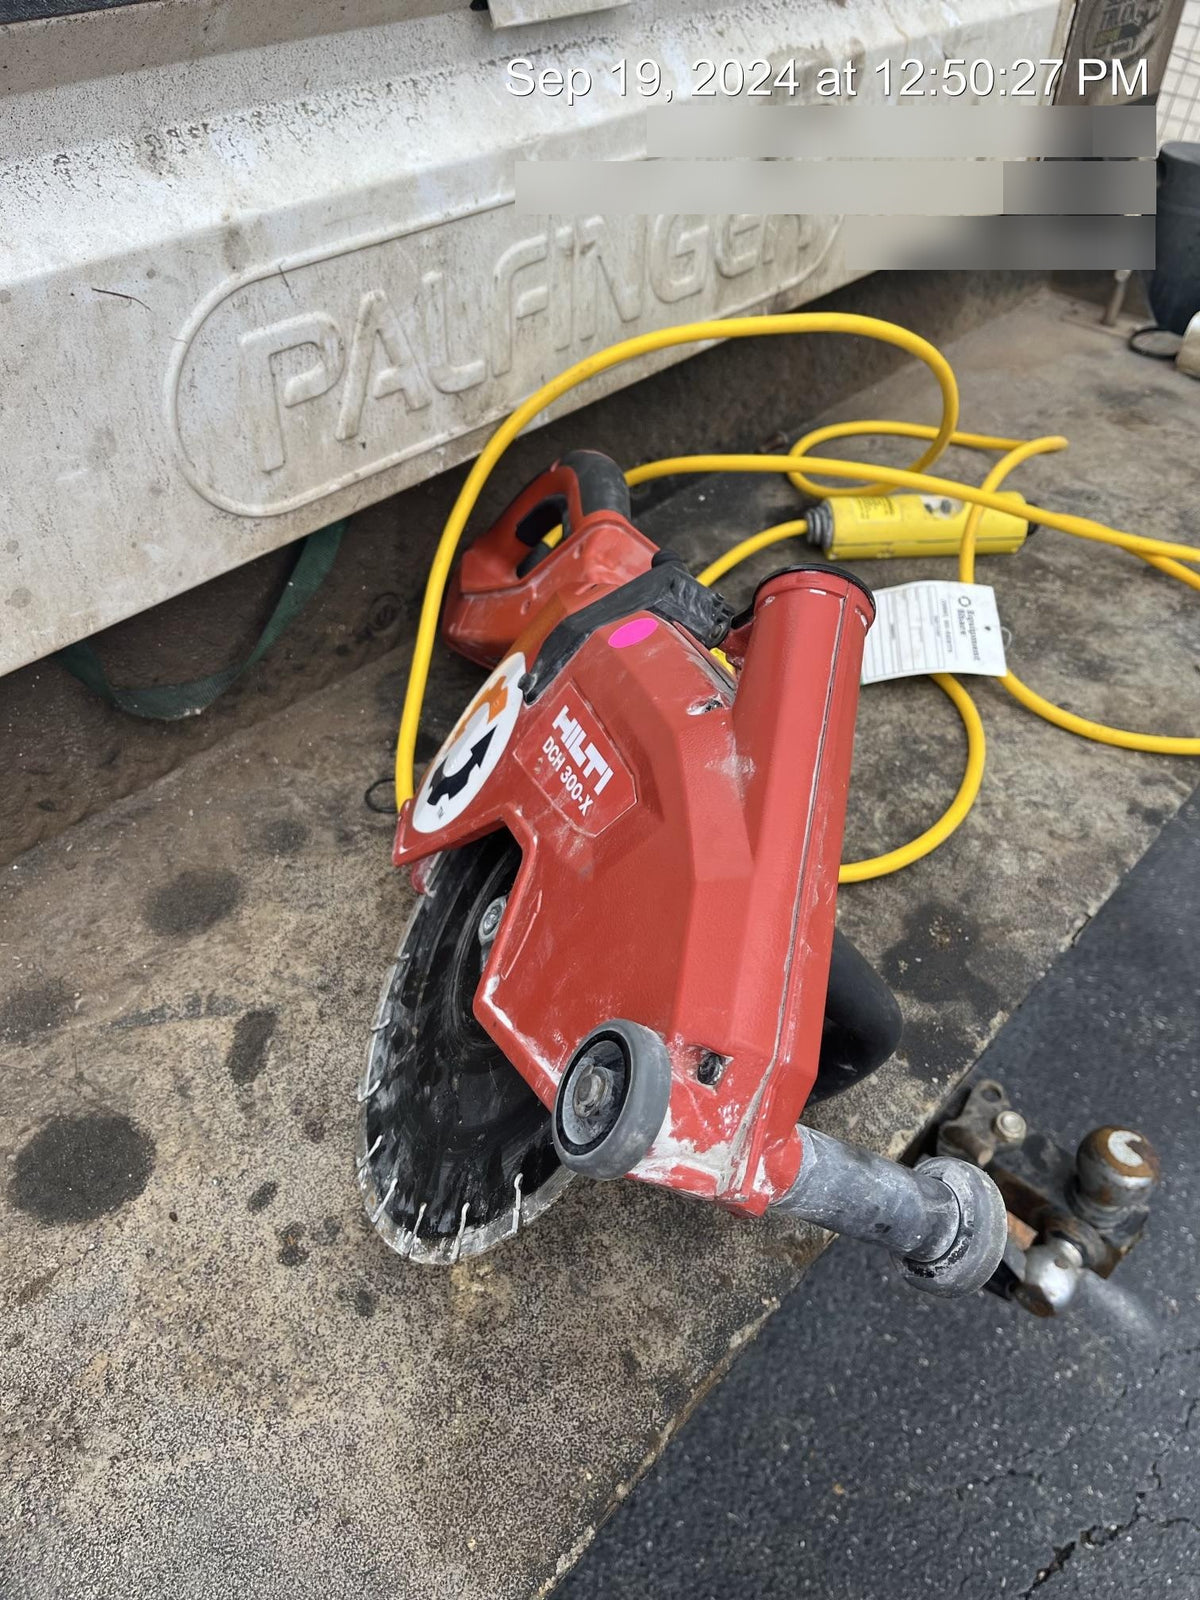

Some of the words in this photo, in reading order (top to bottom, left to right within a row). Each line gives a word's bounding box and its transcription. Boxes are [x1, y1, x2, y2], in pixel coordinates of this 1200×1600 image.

[958, 609, 968, 636] Share
[967, 609, 981, 662] Equipment
[542, 736, 566, 771] DCH
[560, 766, 594, 816] 300-X
[552, 704, 614, 795] HILTI
